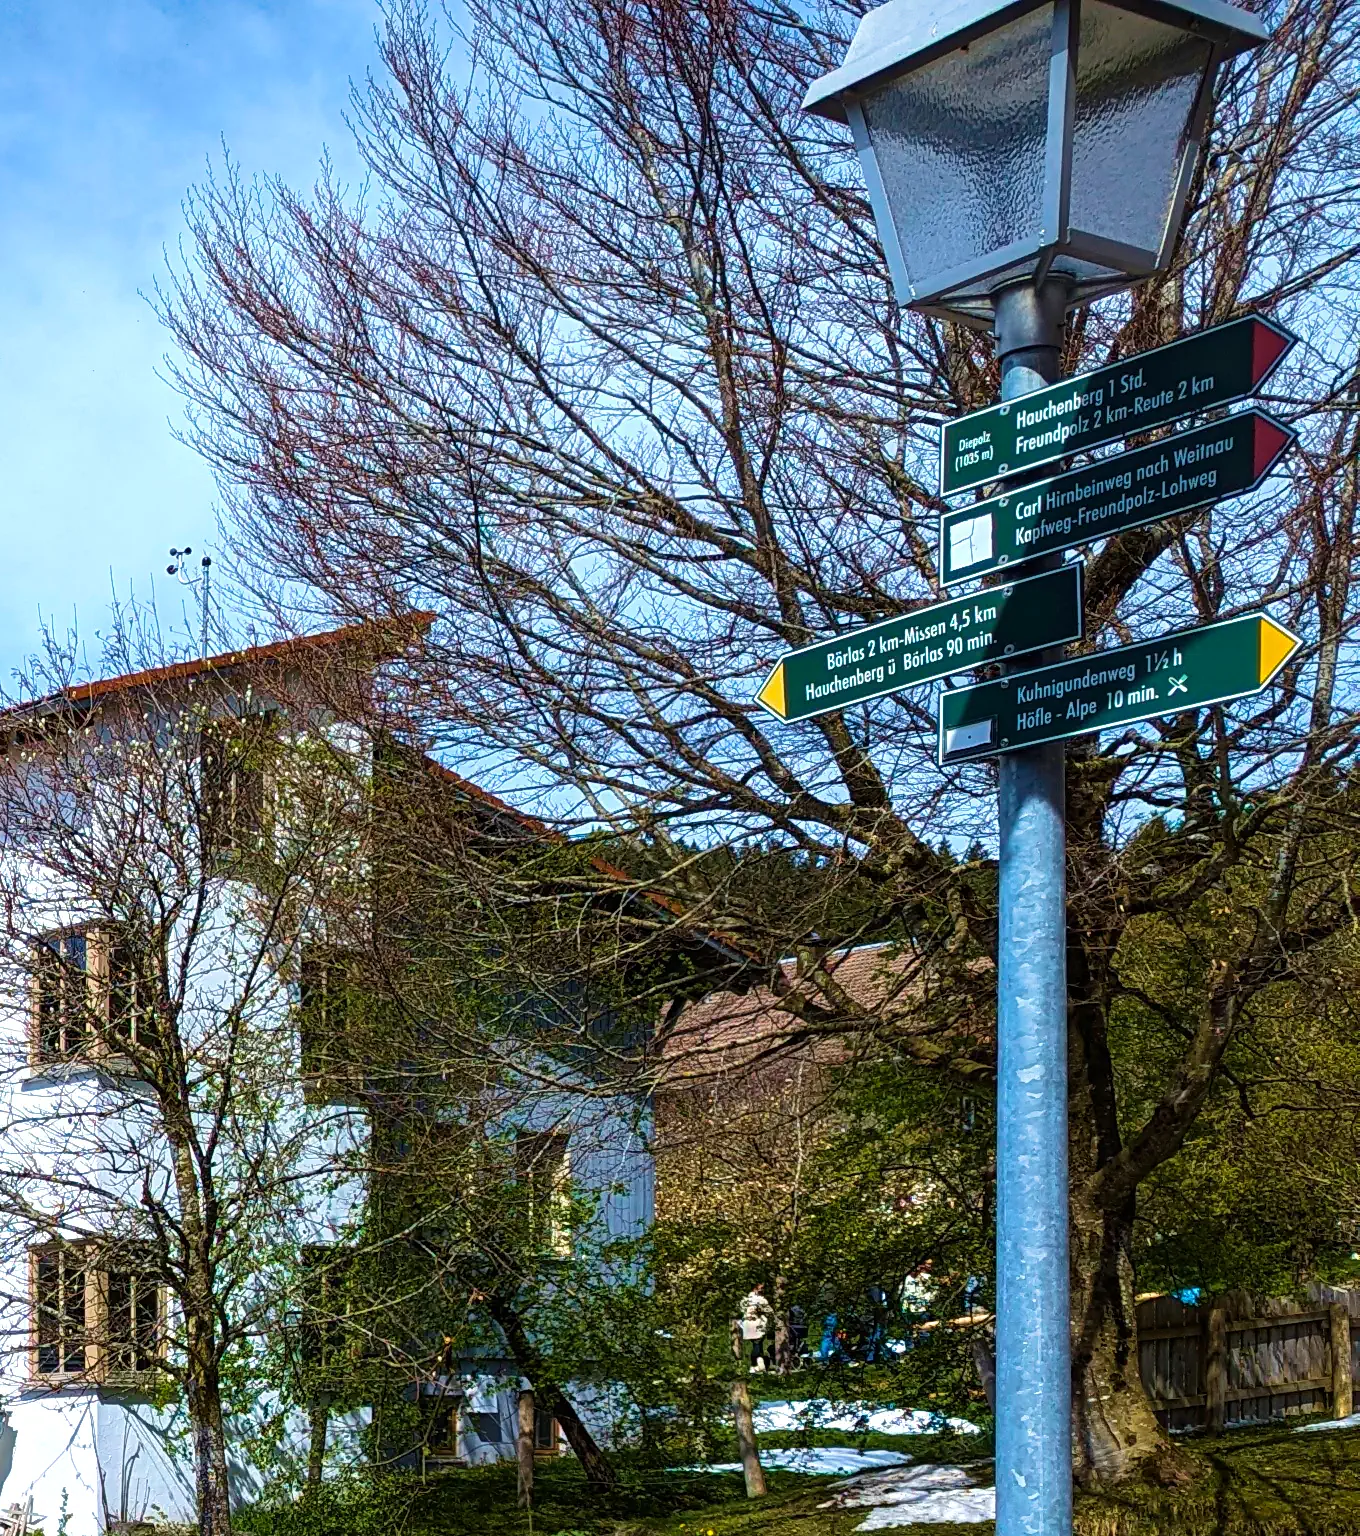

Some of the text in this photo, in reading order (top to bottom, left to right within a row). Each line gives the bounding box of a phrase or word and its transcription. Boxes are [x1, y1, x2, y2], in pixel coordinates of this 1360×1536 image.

[1015, 375, 1214, 455] Freundpolz 2 km-Reute 2 km
[1016, 367, 1148, 430] Hauchenberg 1 Std.
[954, 445, 995, 472] (1035 m)
[958, 431, 992, 453] Diepolz
[1015, 436, 1235, 521] Carl Hirnbeinweg nach Weitnau
[1015, 469, 1218, 546] Kapfweg-Freundpolz-Lohweg
[805, 631, 998, 701] Hauchenberg ü Börlas 90 min.
[826, 605, 997, 671] Börlas 2 km-Missen 4,5 km
[1016, 707, 1052, 731] Höfle
[1065, 698, 1097, 721] Alpe
[1106, 689, 1124, 710] 10
[1127, 685, 1160, 706] min.
[1017, 664, 1136, 705] Kuhnigundenweg
[1173, 647, 1183, 667] h
